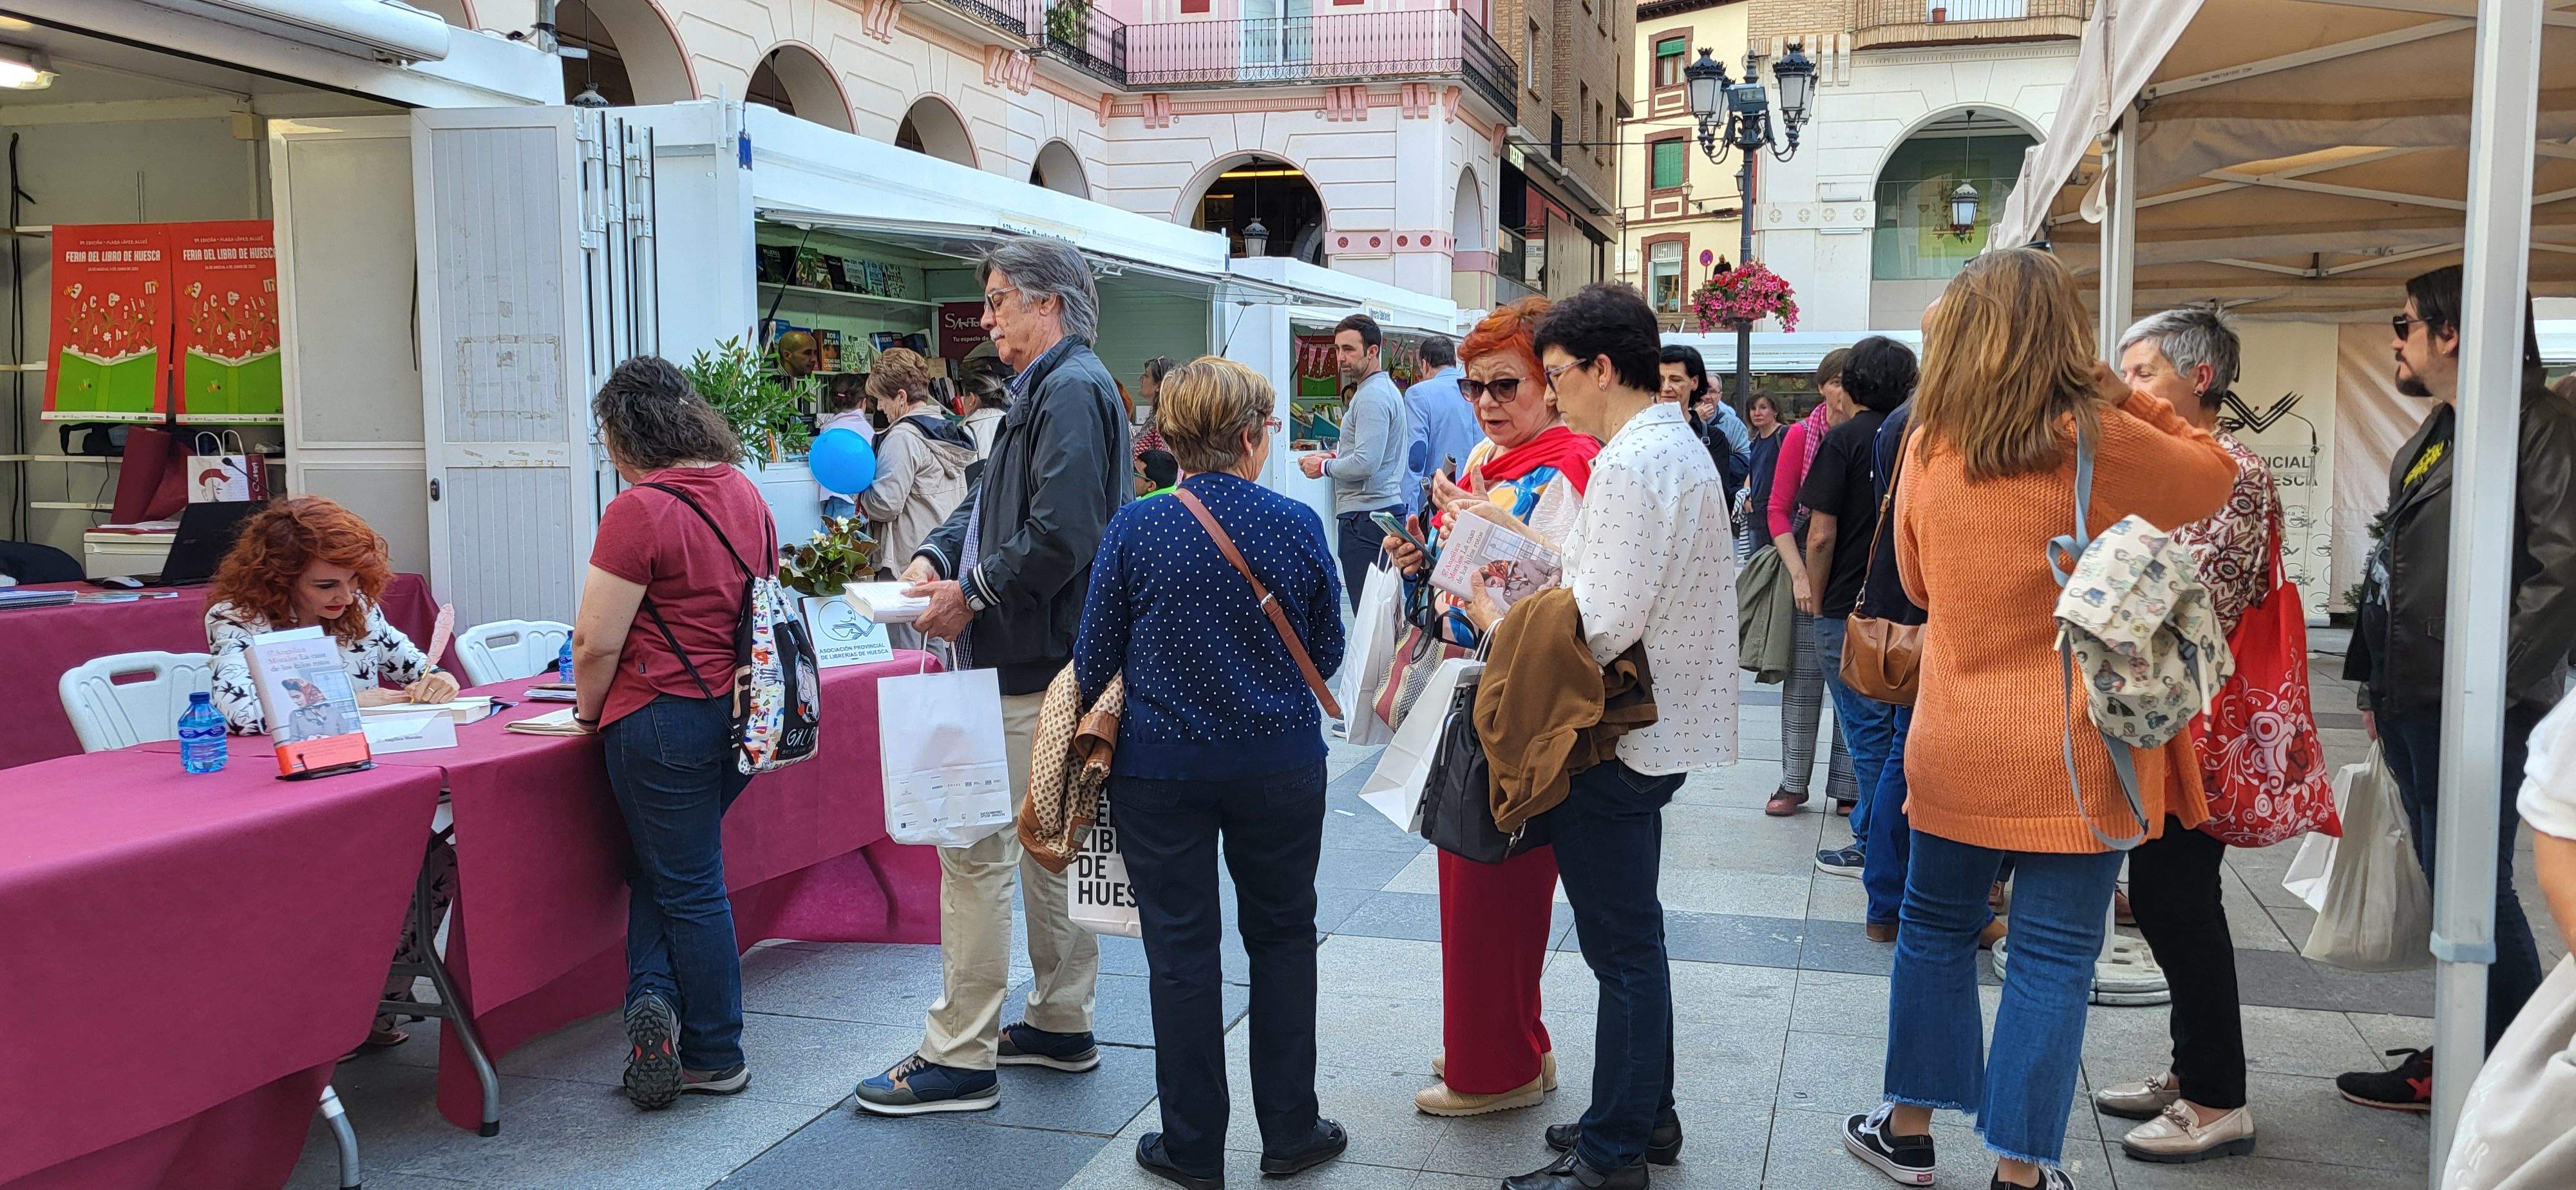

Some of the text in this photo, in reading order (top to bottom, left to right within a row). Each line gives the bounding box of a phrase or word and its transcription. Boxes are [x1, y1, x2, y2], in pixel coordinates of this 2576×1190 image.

[66, 250, 160, 263] FERIA DEL LIBRO DE HUESCA
[183, 249, 202, 261] FERIA
[204, 249, 216, 260] DEL
[217, 248, 237, 260] LIBRO
[239, 247, 248, 259] DE
[1448, 529, 1475, 581] Morales La casa
[1455, 531, 1484, 584] de los hilos rotos
[1078, 855, 1106, 879] DE
[1078, 880, 1138, 908] HUES
